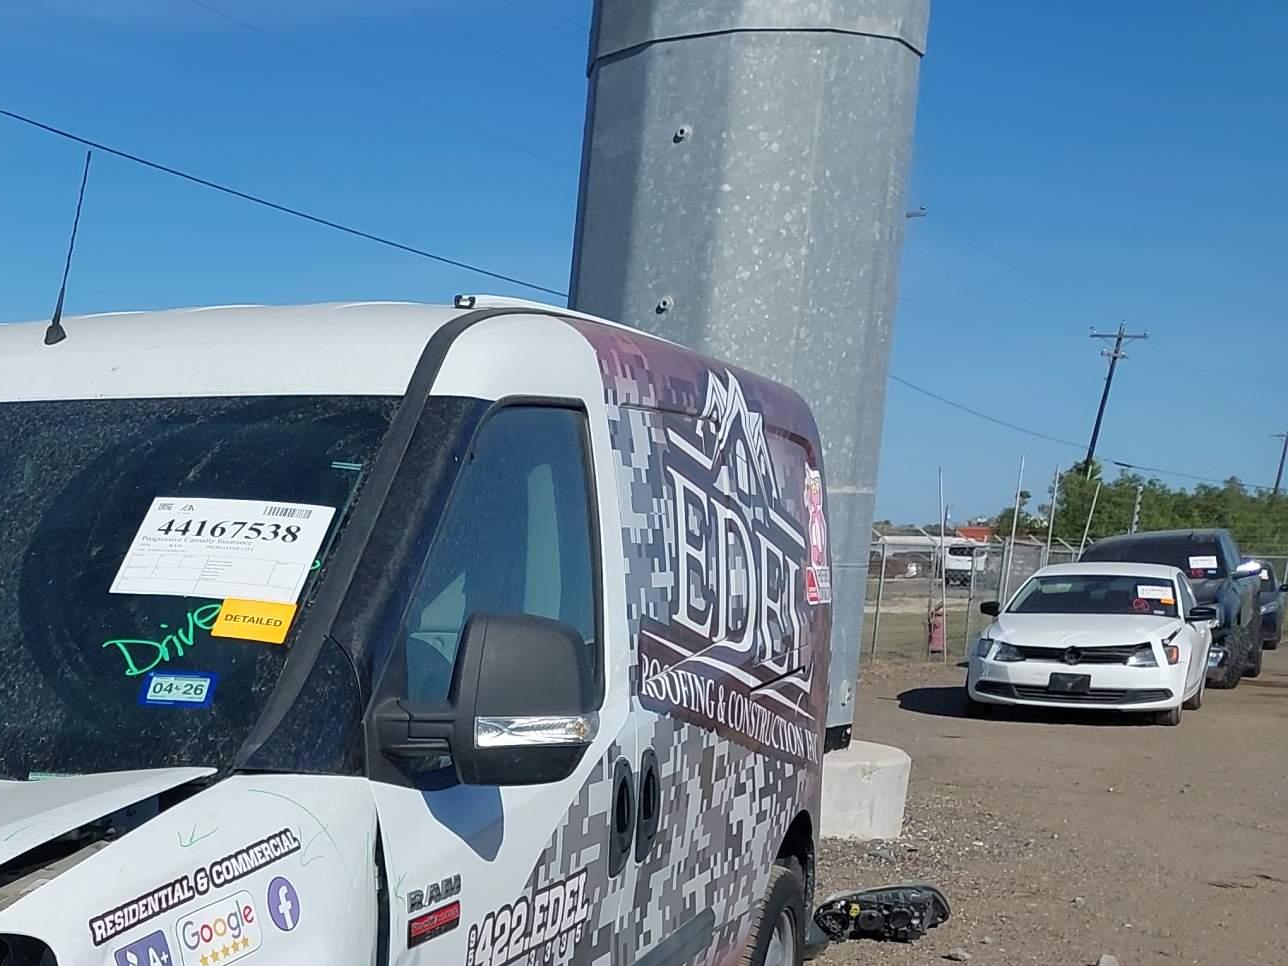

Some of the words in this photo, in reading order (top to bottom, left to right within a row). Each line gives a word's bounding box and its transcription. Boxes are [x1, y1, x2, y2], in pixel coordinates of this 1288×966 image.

[157, 518, 302, 544] 44167538
[217, 538, 254, 547] Insurance
[666, 466, 814, 694] EDEL
[103, 603, 221, 677] Drive
[224, 613, 283, 628] DETAILED
[152, 682, 174, 694] 04
[182, 683, 205, 696] 26
[641, 652, 716, 719] ROOFING
[717, 684, 727, 724] &
[727, 690, 805, 760] CONSTRUCTION
[92, 878, 195, 942] RESIDENTIAL
[195, 870, 209, 892] &
[211, 830, 300, 886] COMMERCIAL
[406, 873, 462, 915] RAM
[182, 900, 255, 950] Google
